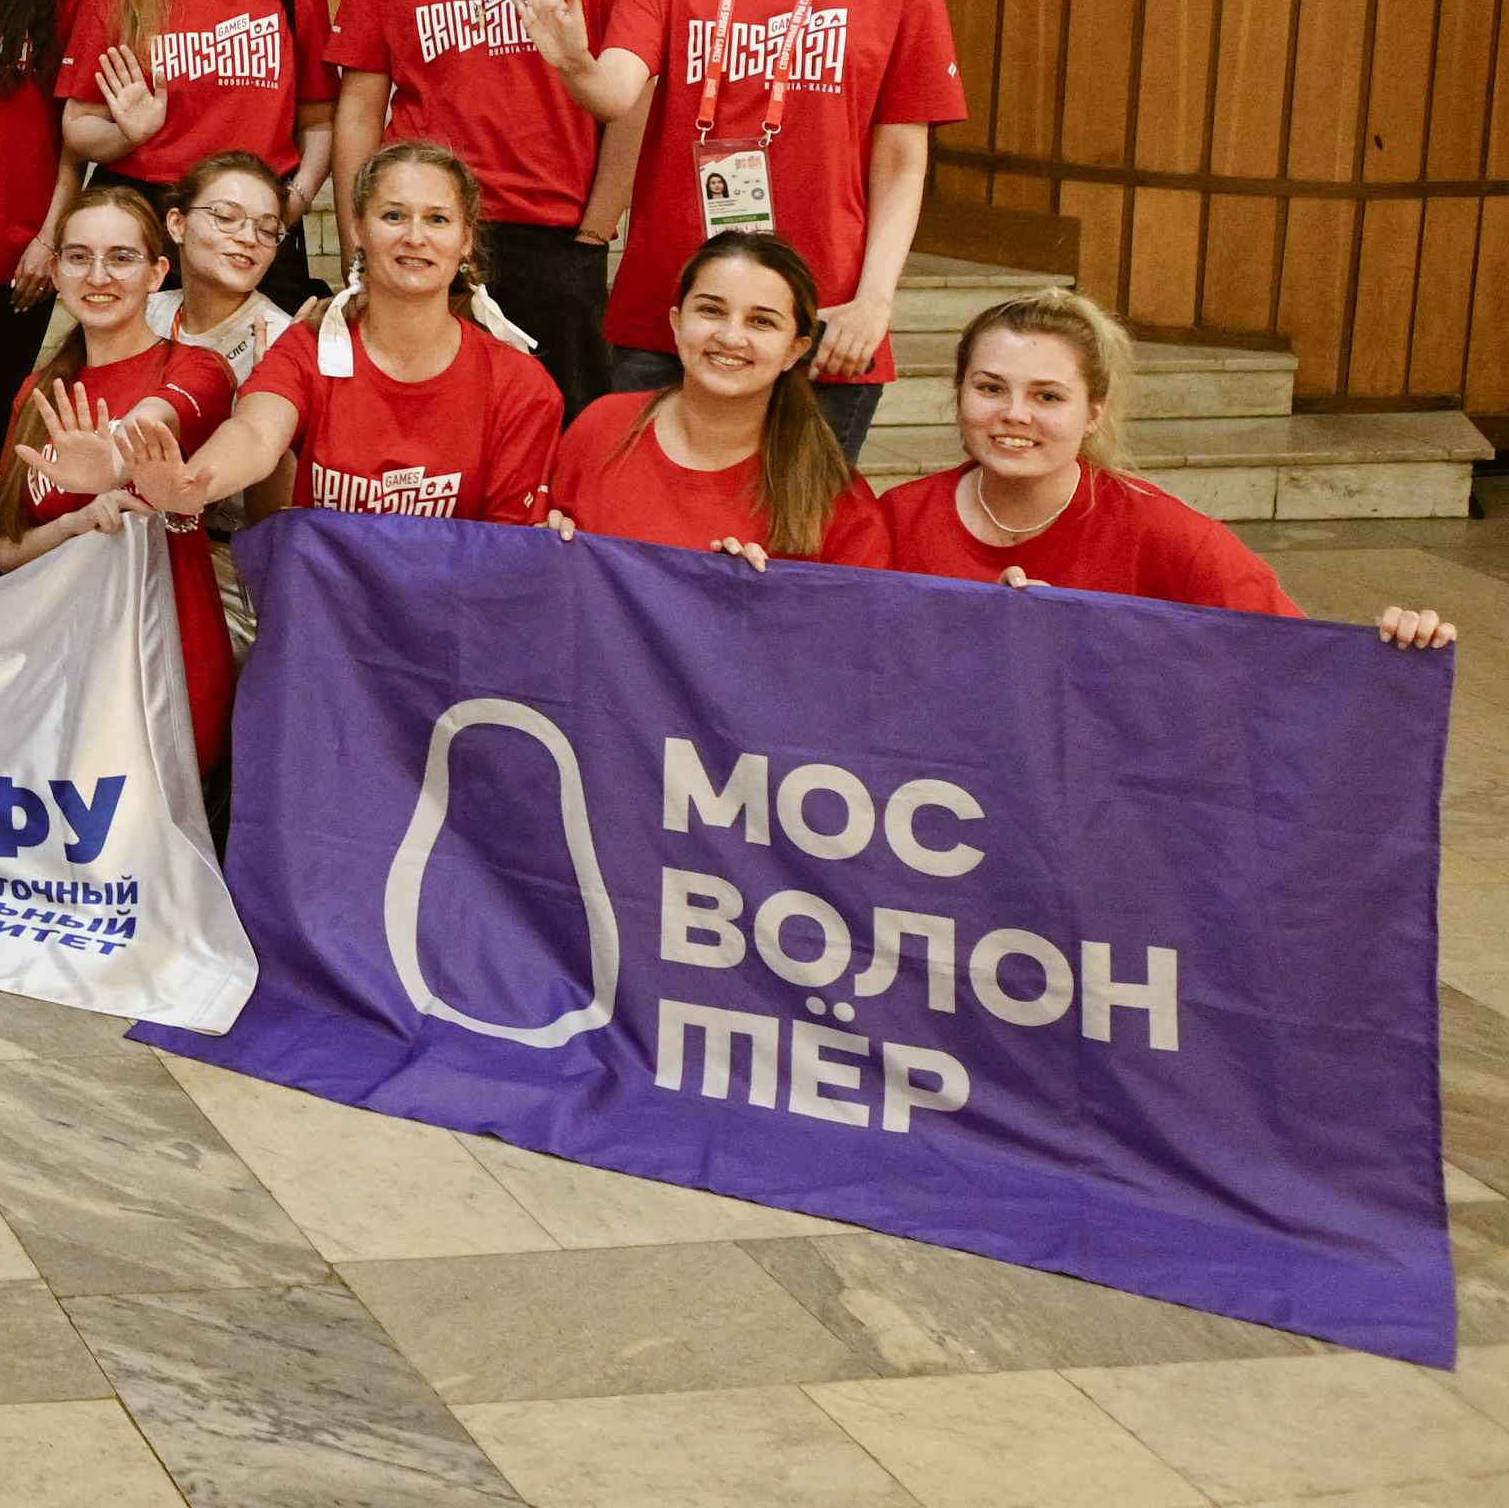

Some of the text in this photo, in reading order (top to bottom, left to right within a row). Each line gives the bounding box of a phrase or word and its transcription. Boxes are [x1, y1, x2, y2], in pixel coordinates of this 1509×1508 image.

[217, 18, 247, 38] GAMES
[385, 472, 421, 488] GAMES
[662, 736, 986, 878] МОС
[660, 865, 1179, 1052] ВОЛОН
